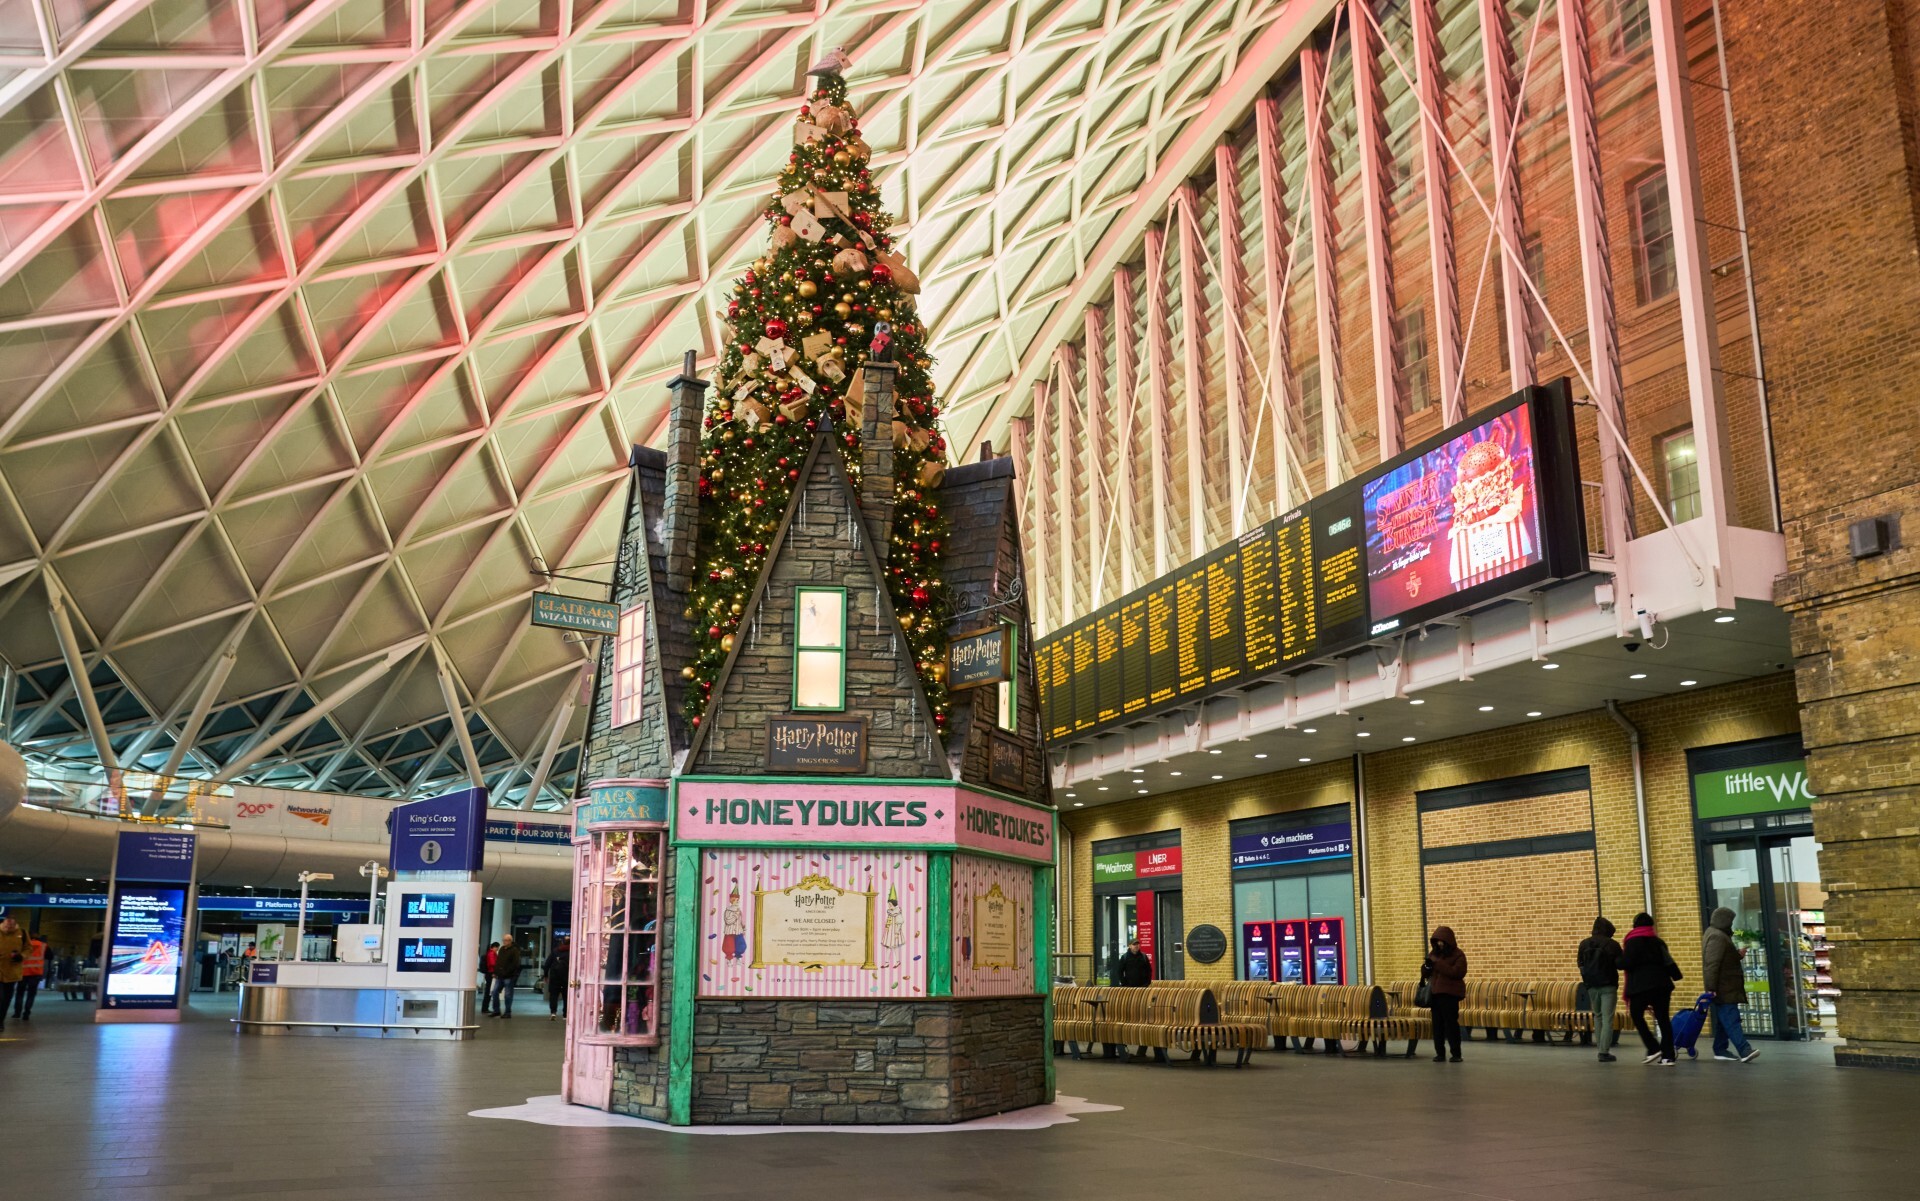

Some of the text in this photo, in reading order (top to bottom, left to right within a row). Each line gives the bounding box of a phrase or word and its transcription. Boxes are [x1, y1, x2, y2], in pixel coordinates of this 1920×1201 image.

[1376, 476, 1441, 525] STRANGER
[1283, 509, 1302, 524] Arrivals
[1382, 507, 1439, 555] BURGER
[539, 599, 614, 620] GLADRAGS
[952, 637, 1001, 672] Harry Potter
[986, 657, 1000, 668] SHOP
[773, 723, 858, 752] Harry Potter
[1725, 772, 1765, 795] little
[237, 802, 266, 819] 200
[705, 798, 928, 827] HONEYDUKES
[409, 814, 457, 825] King's Cross
[966, 805, 1044, 846] HONEYDUKES
[490, 826, 508, 836] PART
[511, 827, 521, 836] OF
[523, 829, 538, 838] OUR
[540, 829, 554, 839] 200
[1270, 832, 1314, 845] Cash machines
[1308, 847, 1326, 855] Platforms
[1148, 853, 1167, 865] LNER
[1105, 862, 1134, 874] Waitrose
[1161, 864, 1176, 872] LOUNGE
[58, 897, 88, 905] Platforms
[265, 901, 292, 909] Platforms
[794, 893, 836, 908] Harry Potter
[341, 910, 351, 922] 9
